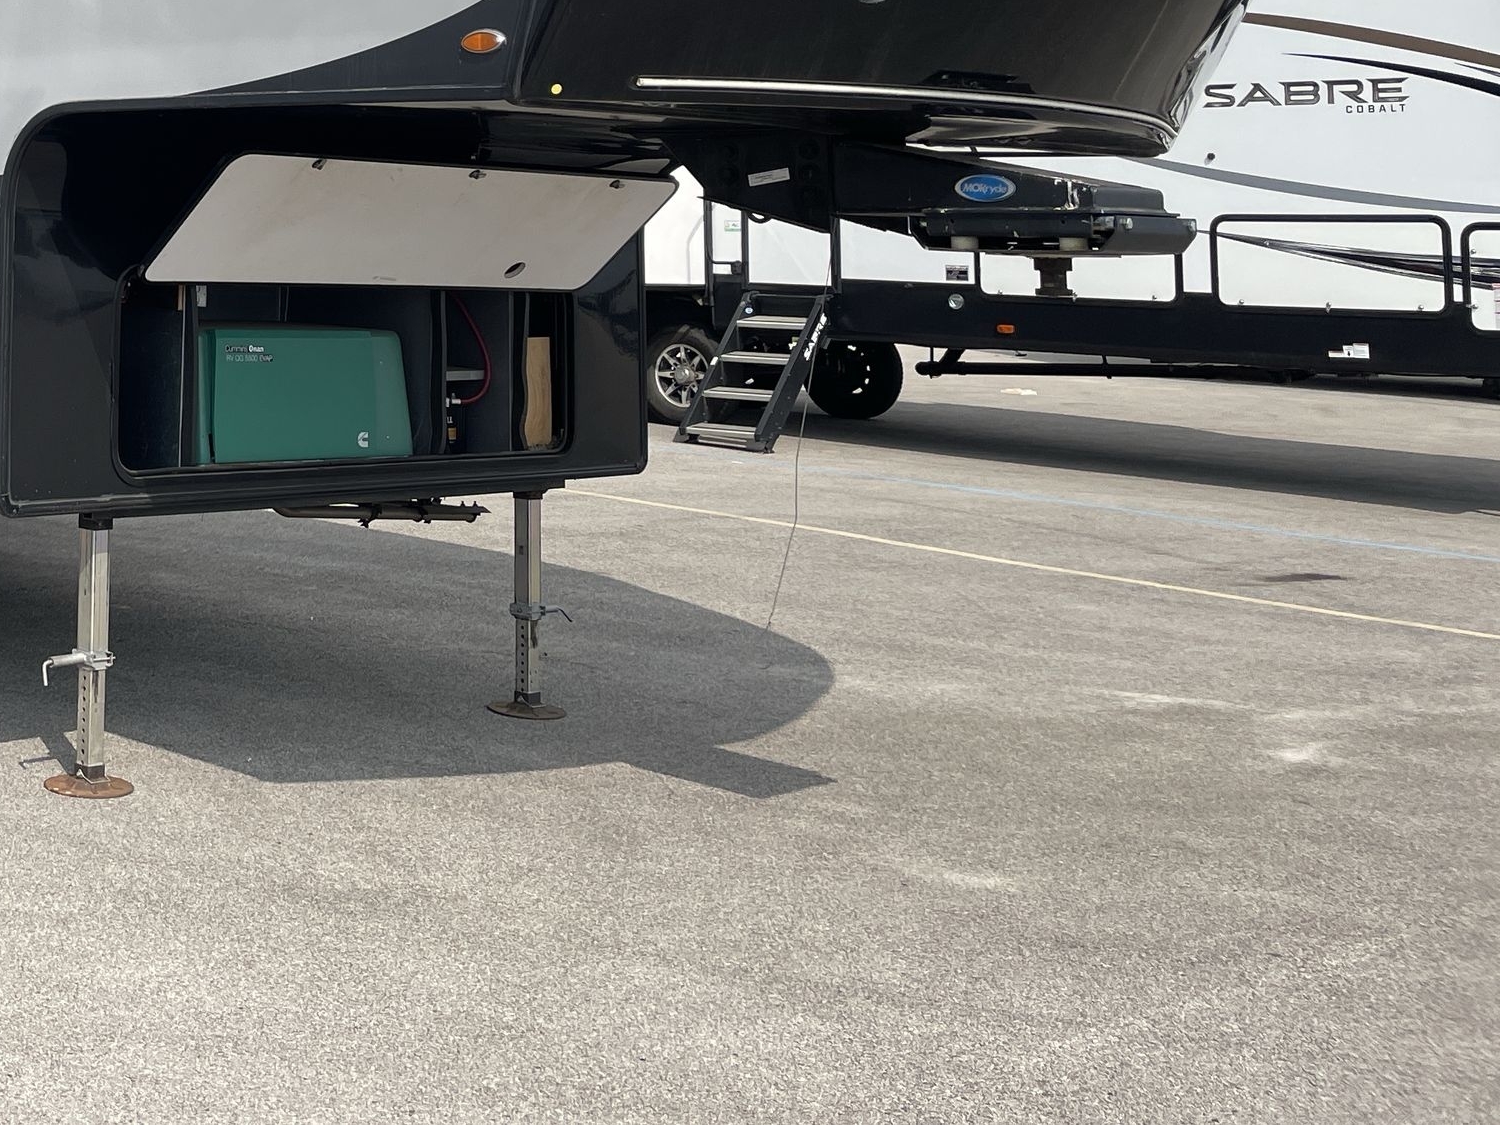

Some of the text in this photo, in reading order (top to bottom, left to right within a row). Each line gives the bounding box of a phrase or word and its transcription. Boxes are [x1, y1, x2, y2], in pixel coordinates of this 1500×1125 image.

[1203, 77, 1410, 108] SABRE
[1345, 104, 1406, 113] COBALT
[803, 312, 828, 362] SABRE
[248, 344, 265, 353] Onan
